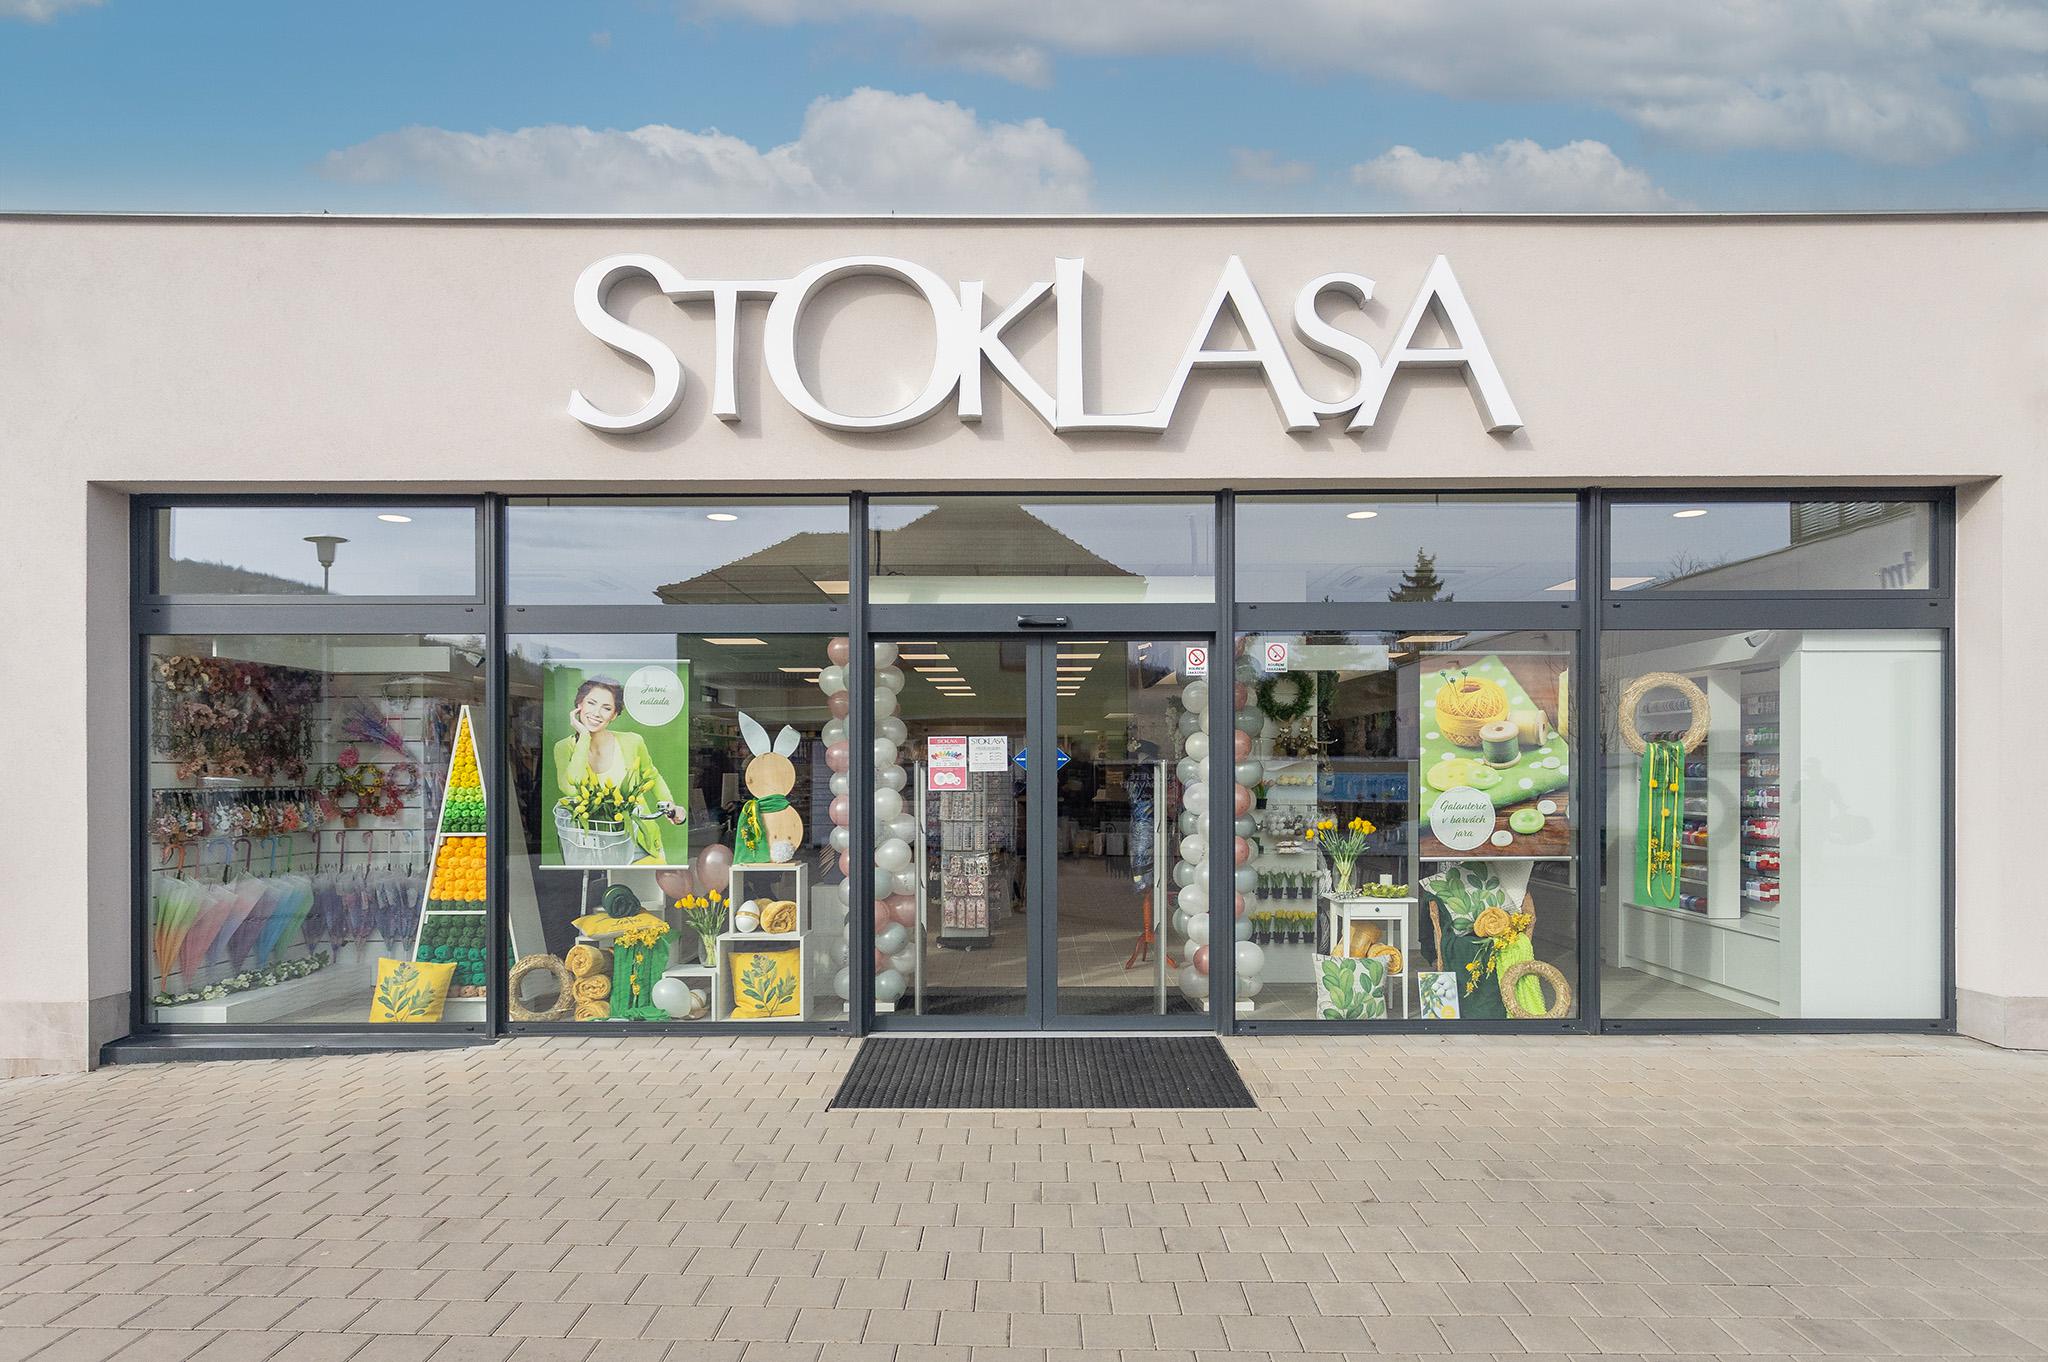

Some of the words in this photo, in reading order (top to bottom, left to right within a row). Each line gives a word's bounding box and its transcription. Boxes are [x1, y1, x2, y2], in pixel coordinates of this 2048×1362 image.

[567, 252, 1524, 435] STOKLASA
[1440, 800, 1487, 812] Galanterie
[1449, 815, 1487, 824] barvách
[1452, 829, 1474, 840] jara
